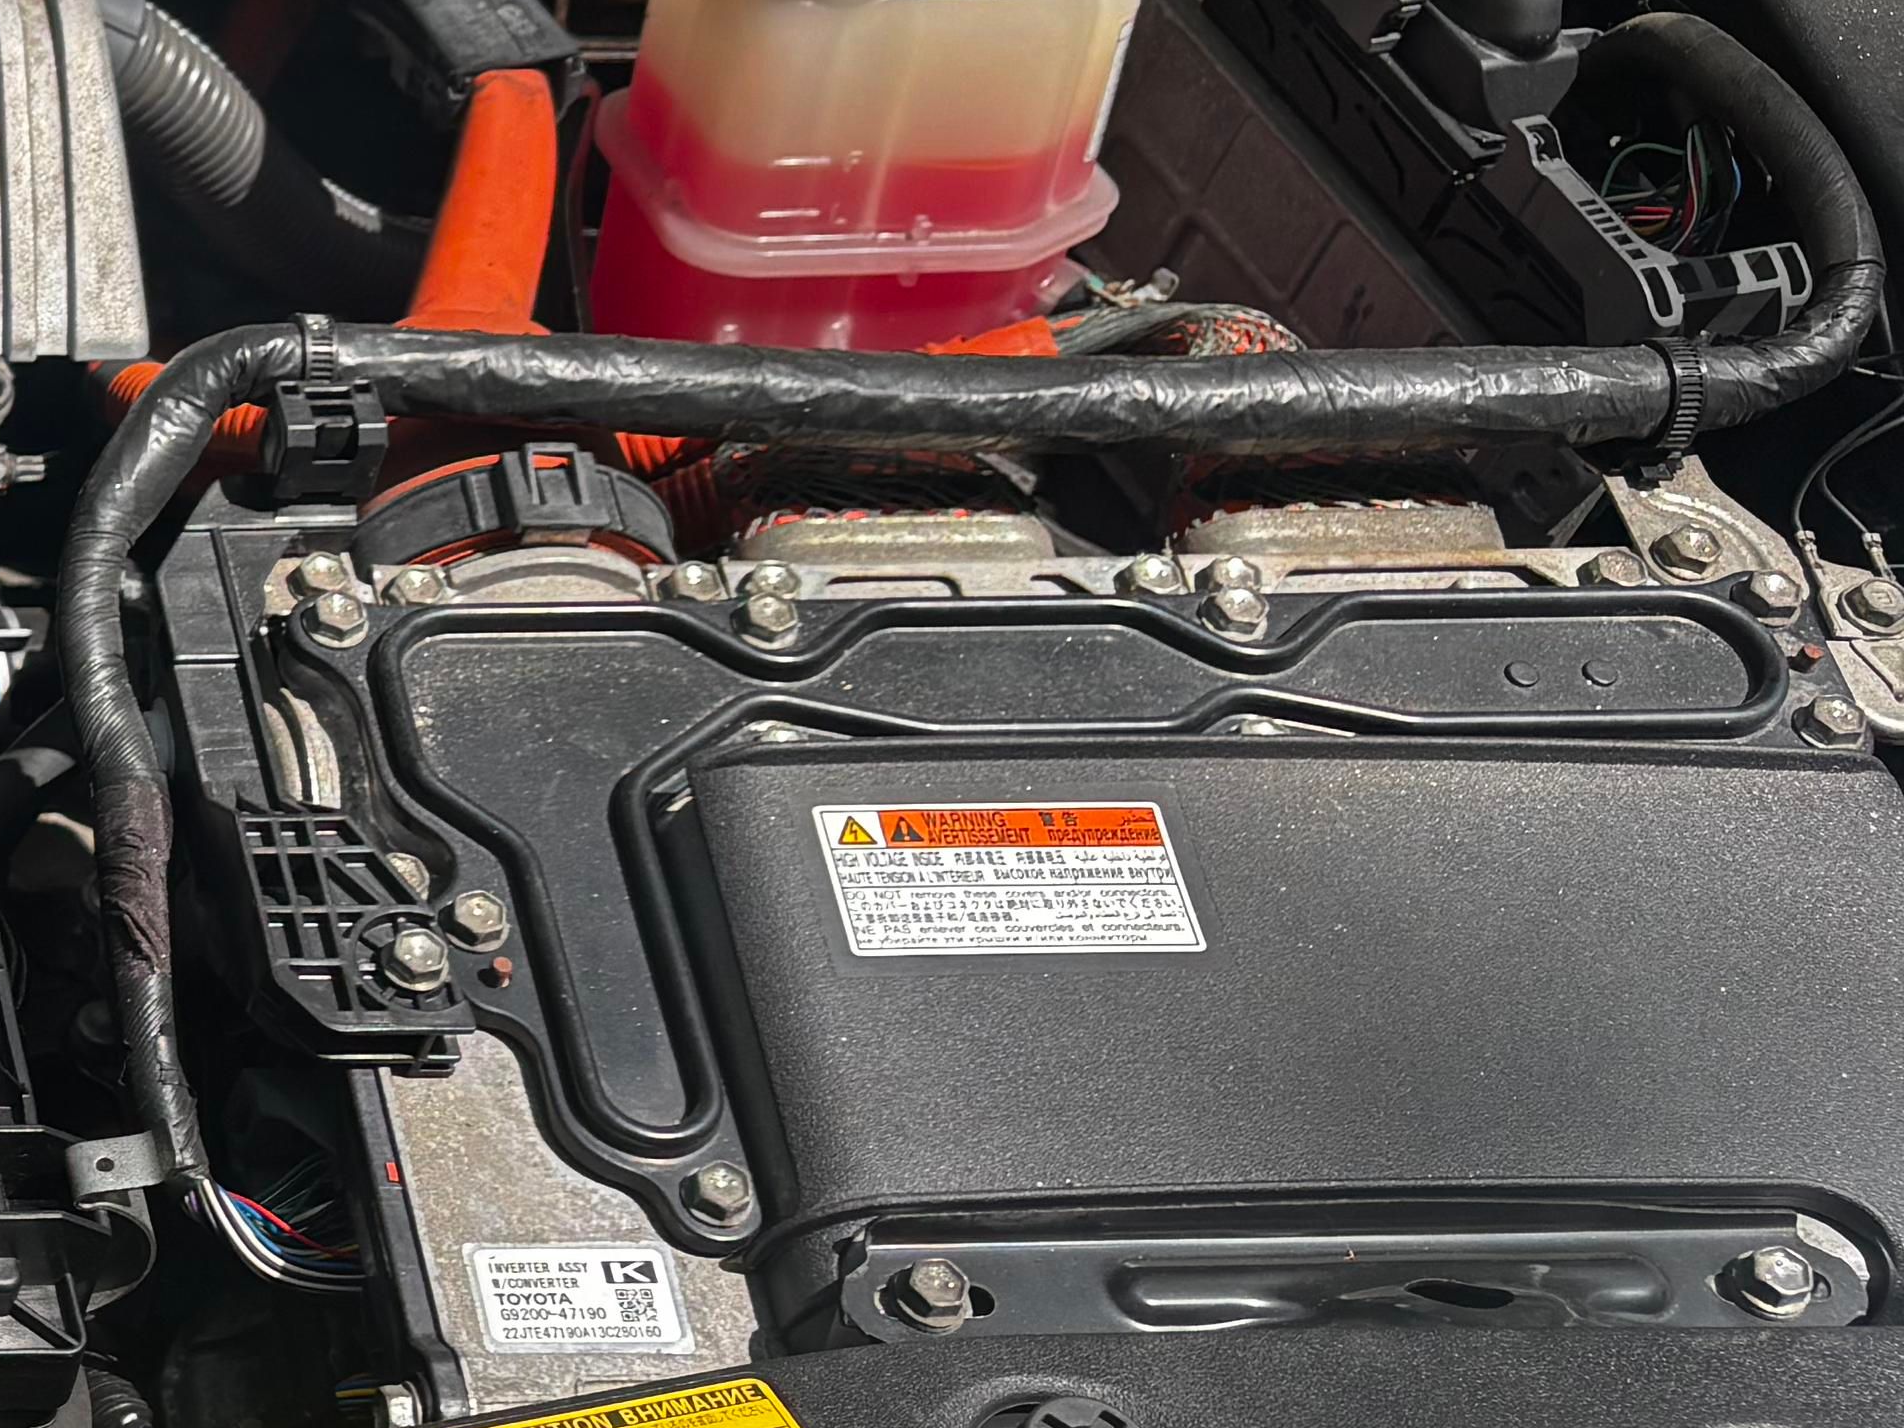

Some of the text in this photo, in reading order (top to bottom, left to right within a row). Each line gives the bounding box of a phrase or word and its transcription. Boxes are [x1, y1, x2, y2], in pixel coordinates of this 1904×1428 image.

[920, 812, 1007, 828] WARNING
[924, 827, 1033, 843] AVERTISSEMENT
[833, 852, 860, 866] HIGH
[863, 852, 908, 866] VOLTAGE
[911, 852, 944, 865] INSIDE
[839, 871, 916, 883] HAUTE TENSION
[845, 891, 866, 900] DO
[873, 890, 902, 899] NOT
[962, 889, 997, 898] these
[854, 925, 876, 934] NE
[883, 924, 911, 933] PAS
[1081, 923, 1094, 931] et
[488, 1261, 652, 1283] INVERTER ASSY K
[492, 1277, 580, 1289] W/CONVERTER
[493, 1292, 573, 1305] TOYOTA
[500, 1307, 607, 1321] G9200-47190
[617, 1385, 762, 1425] ВНИМАНИЕ
